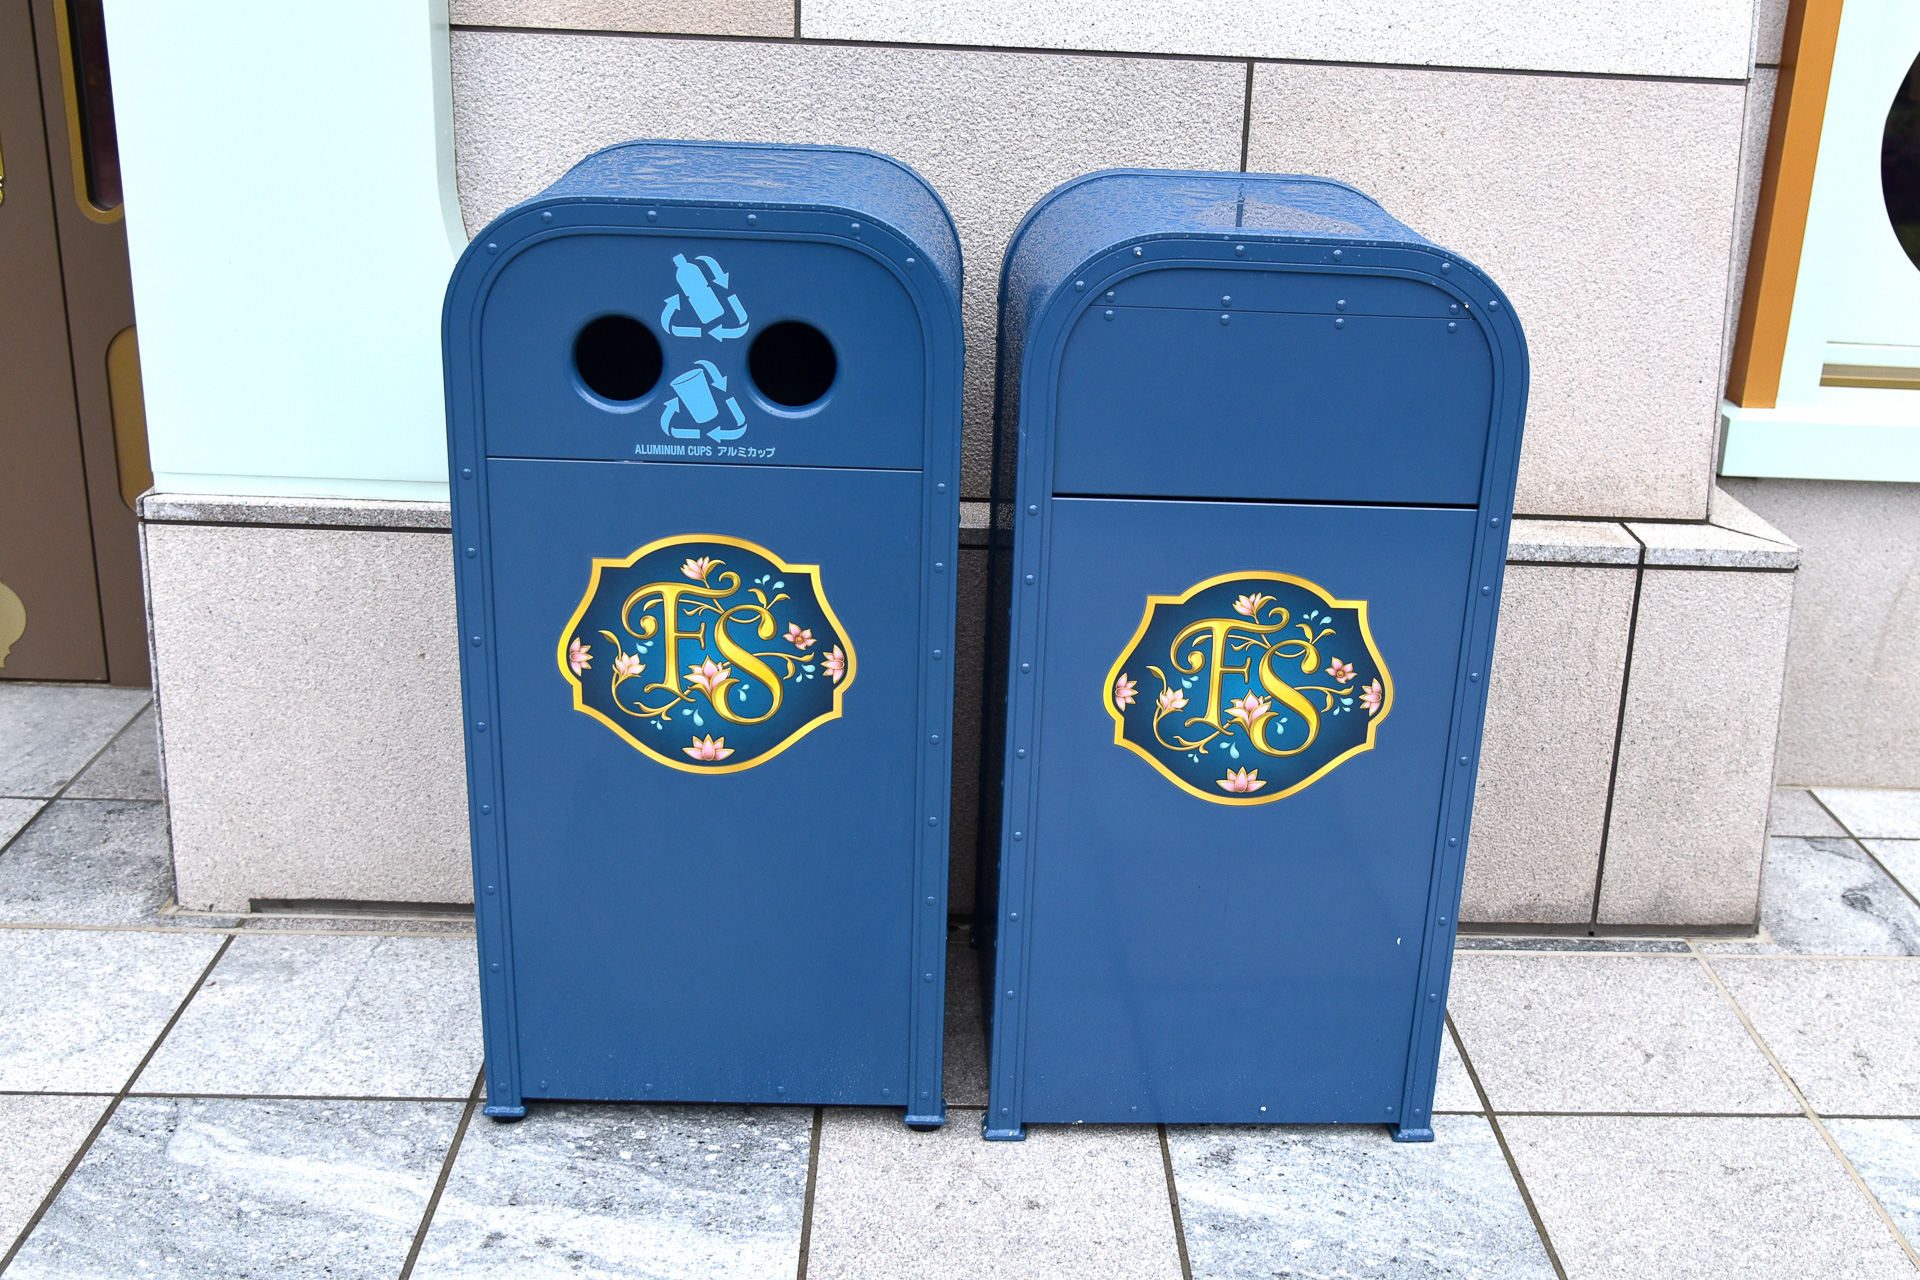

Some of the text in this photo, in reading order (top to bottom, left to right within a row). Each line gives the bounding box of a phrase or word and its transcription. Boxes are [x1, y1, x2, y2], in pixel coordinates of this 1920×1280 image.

[635, 444, 775, 458] ALUMINUM CUPS アルミカップ
